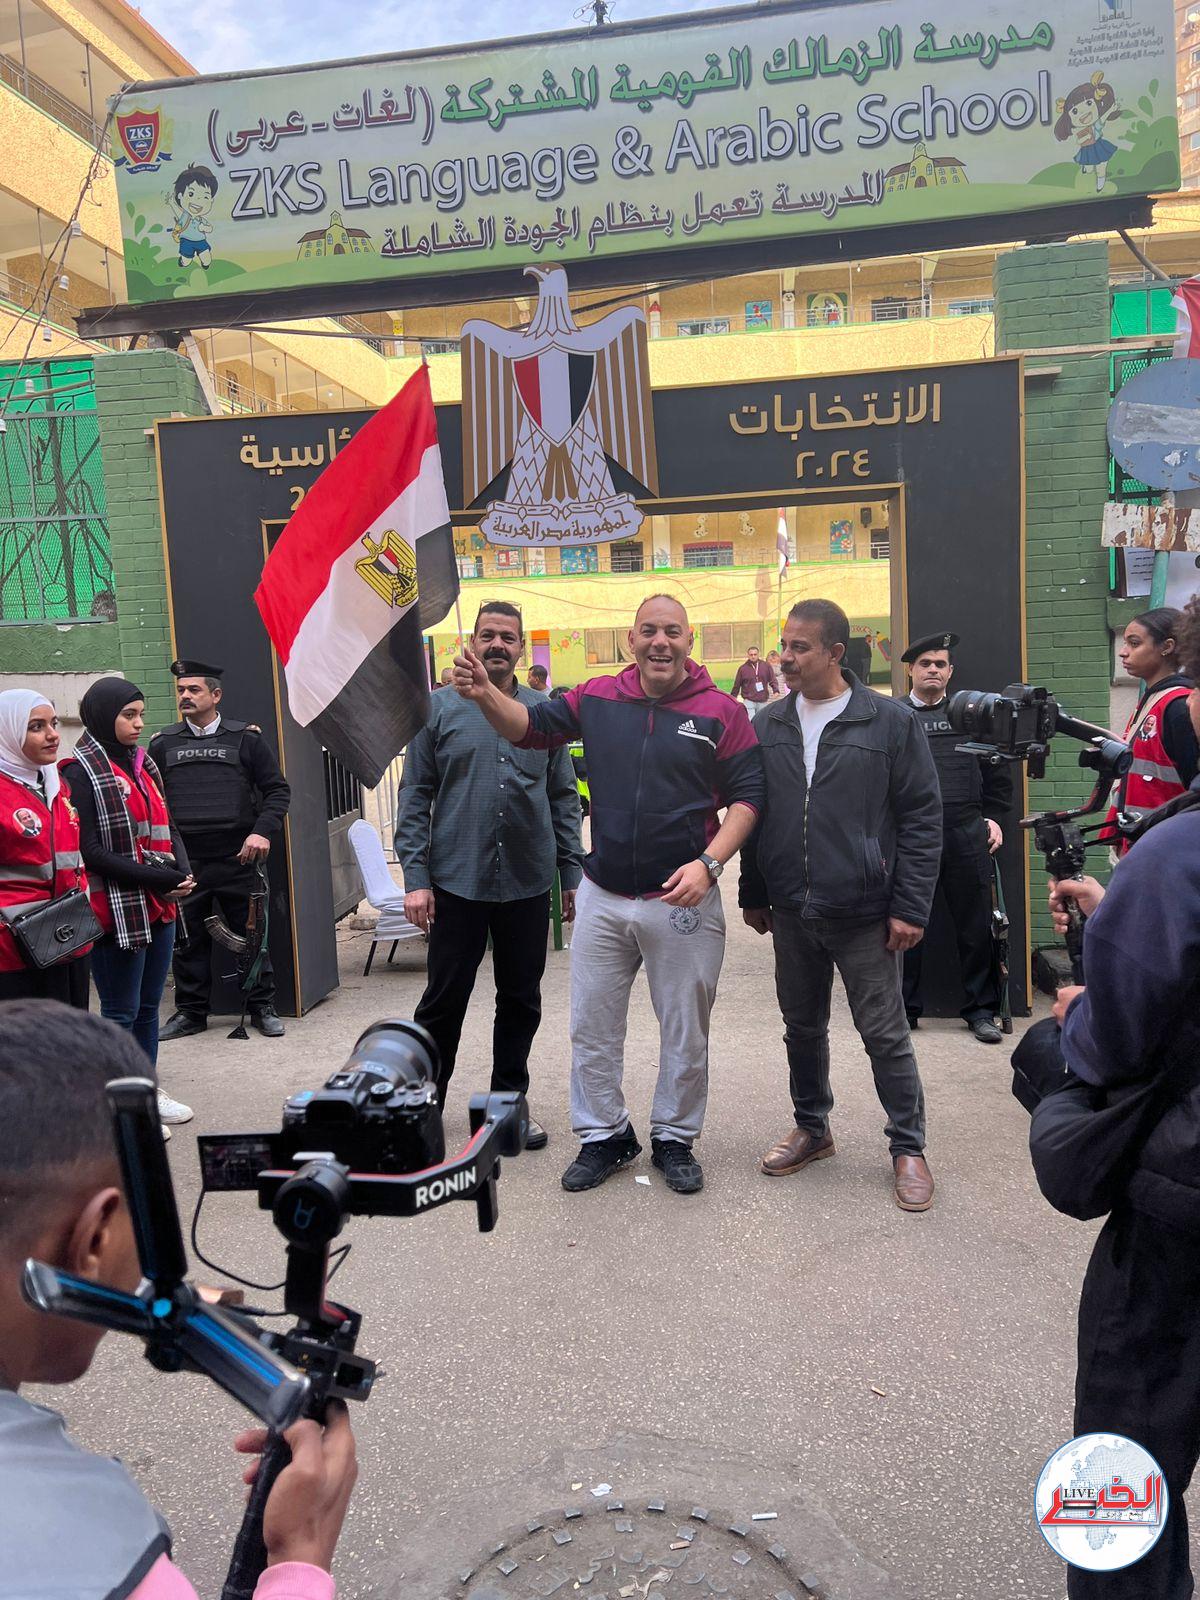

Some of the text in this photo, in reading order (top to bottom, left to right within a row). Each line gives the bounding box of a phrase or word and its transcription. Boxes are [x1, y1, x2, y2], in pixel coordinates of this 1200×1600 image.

[764, 24, 902, 83] الزمالك
[914, 21, 1054, 66] مدرسة
[441, 65, 599, 129] المشتركة
[609, 44, 751, 112] القومية
[129, 126, 152, 140] ZKS
[229, 69, 1053, 220] ZKS Language & Arabic School
[380, 169, 885, 258] المدرسة تعمل بنظام الجودة الشاملة
[729, 383, 941, 441] الانتخابات
[492, 509, 632, 542] جمهورية مصر العربية
[923, 721, 952, 732] LIC
[176, 748, 227, 760] POLICE
[414, 1166, 477, 1209] RONIN
